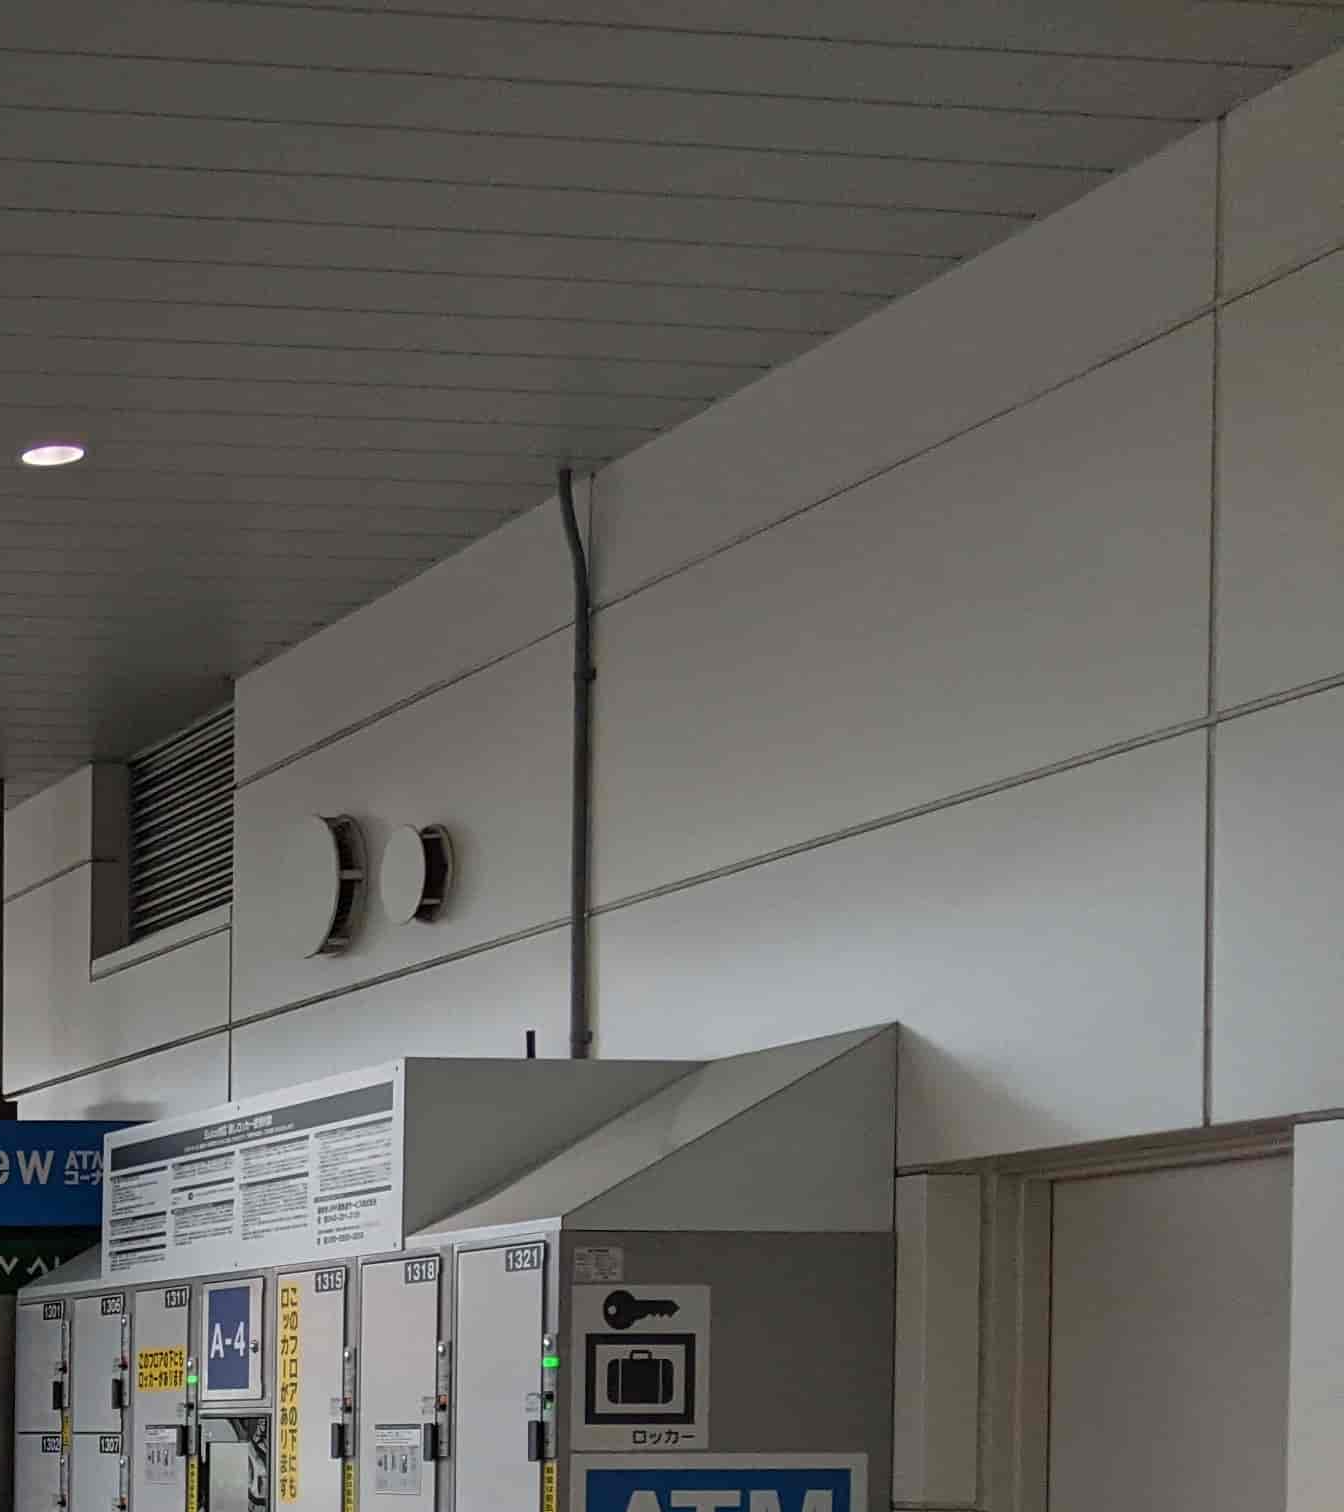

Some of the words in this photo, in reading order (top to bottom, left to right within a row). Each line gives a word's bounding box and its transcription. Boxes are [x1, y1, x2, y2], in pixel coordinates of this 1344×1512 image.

[64, 1170, 105, 1185] コーナ
[507, 1249, 539, 1270] 1321
[406, 1262, 435, 1282] 1318
[316, 1273, 342, 1291] 1315
[167, 1290, 187, 1307] 1311
[45, 1304, 62, 1319] 1301
[210, 1321, 246, 1359] A-4
[101, 1436, 120, 1452] 1307
[632, 1429, 695, 1445] ロッカー
